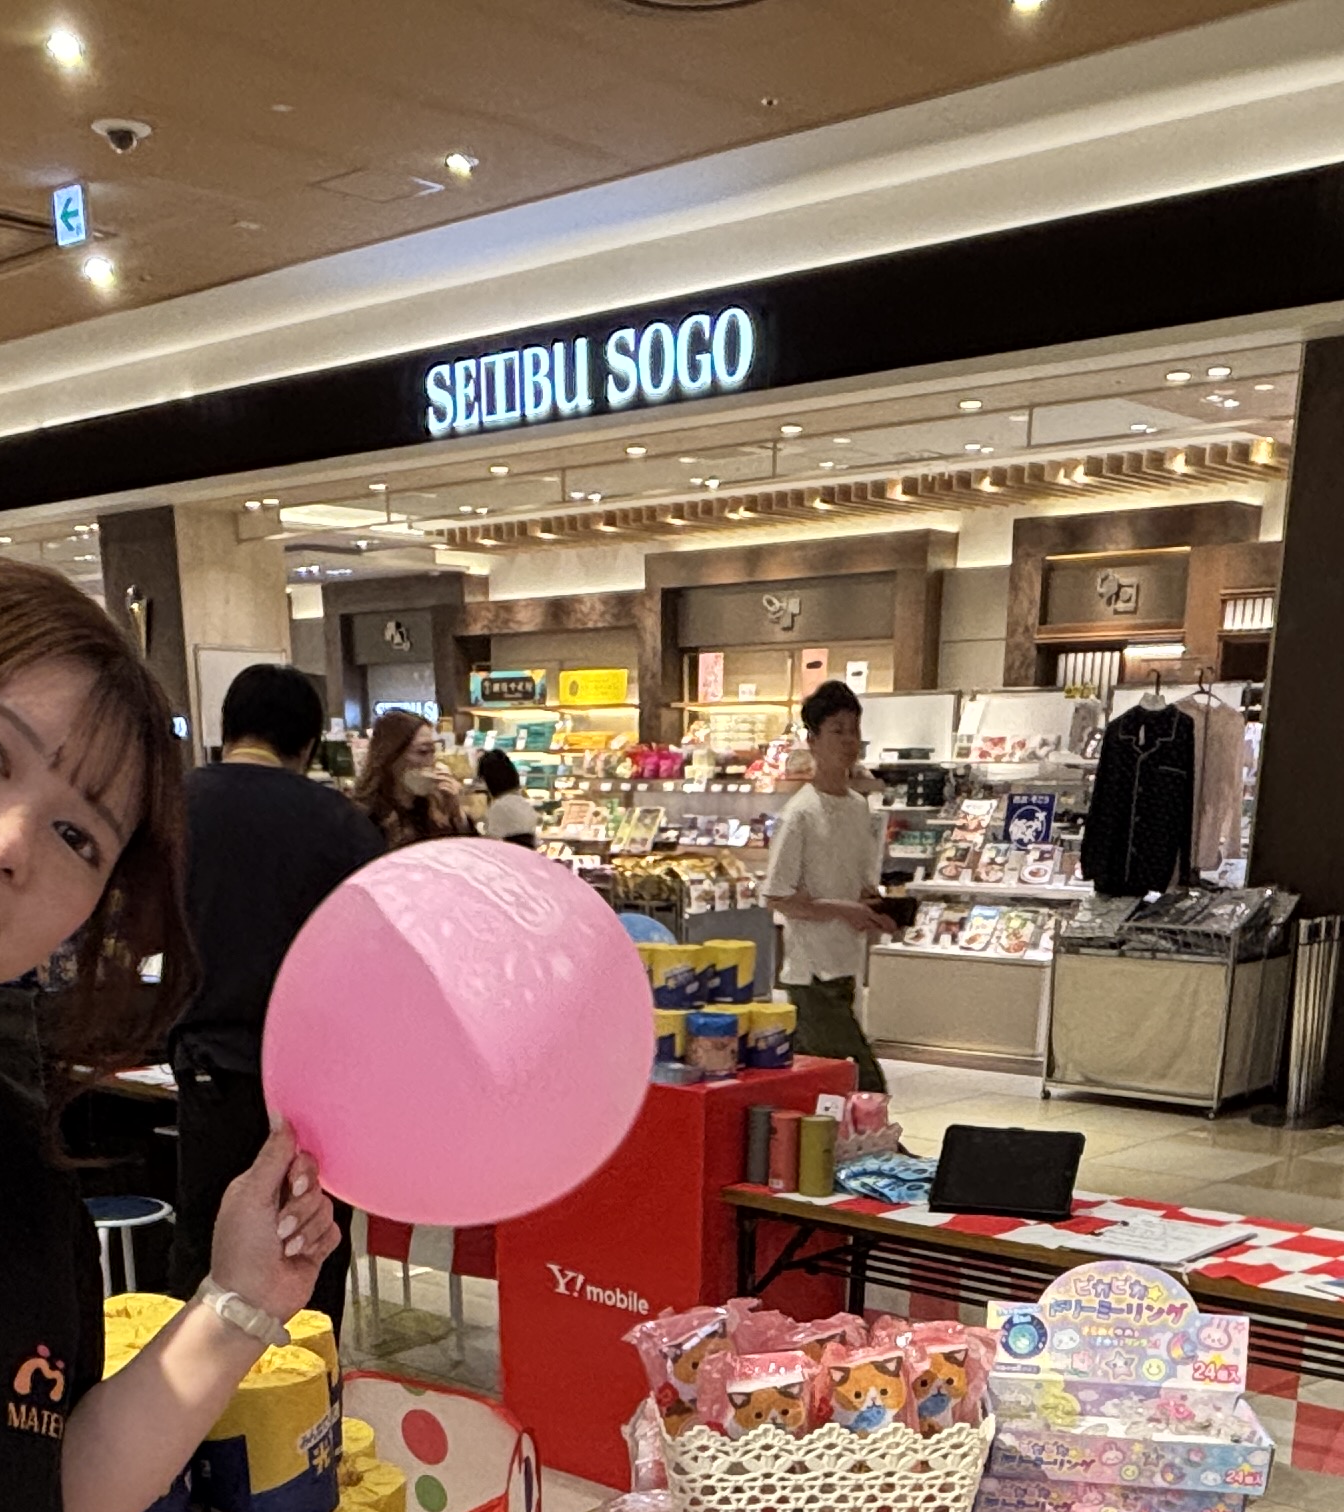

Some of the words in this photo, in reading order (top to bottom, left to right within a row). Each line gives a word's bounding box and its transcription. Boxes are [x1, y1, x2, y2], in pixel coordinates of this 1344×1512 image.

[425, 337, 594, 437] SEIBU
[606, 306, 754, 408] SOGO
[1073, 1275, 1148, 1300] ピカピカ
[1049, 1300, 1188, 1324] ドリーミーリング
[8, 1402, 65, 1439] MATE
